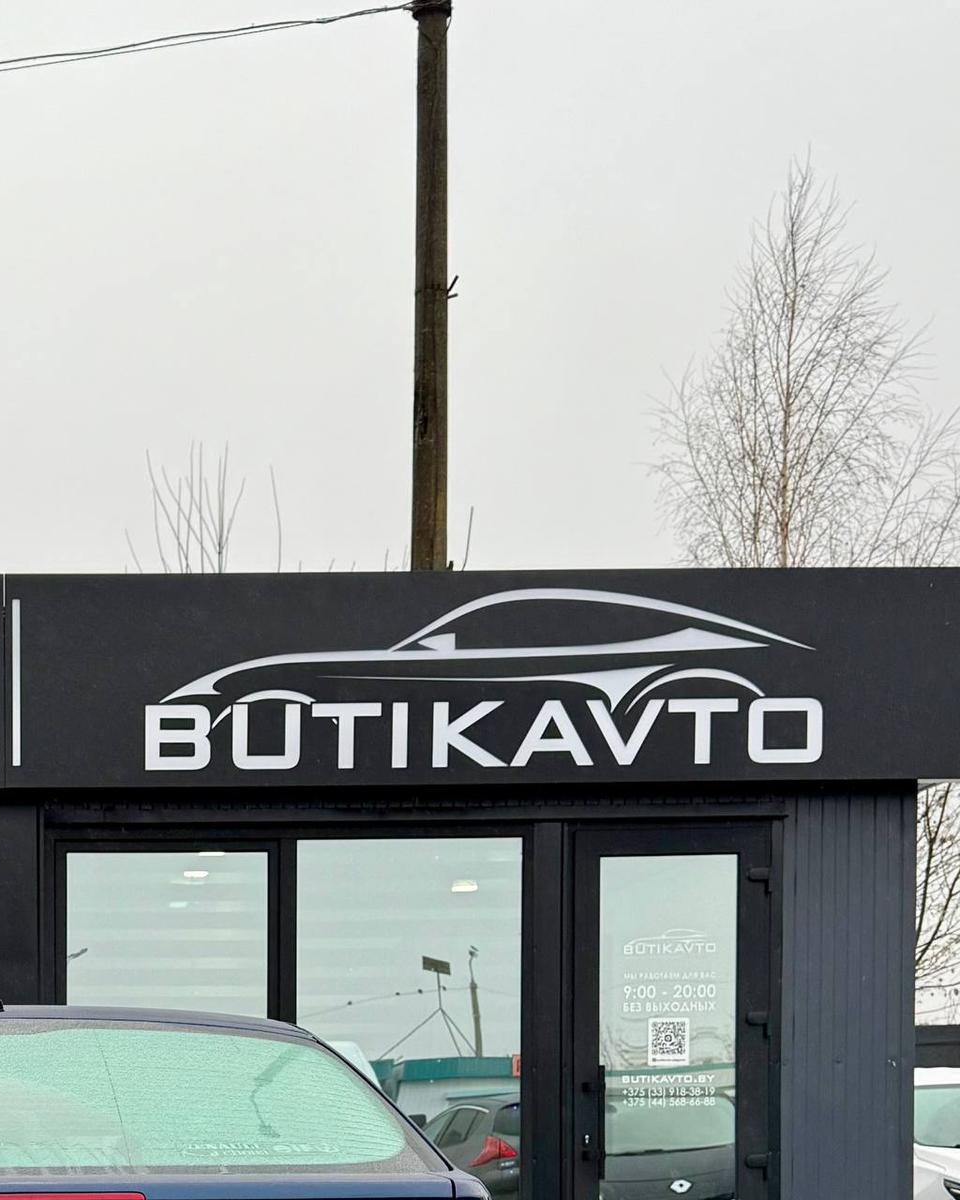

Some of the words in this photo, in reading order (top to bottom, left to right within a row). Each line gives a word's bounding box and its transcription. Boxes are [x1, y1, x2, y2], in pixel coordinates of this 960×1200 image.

[144, 697, 823, 772] BUTIKAVTO
[623, 943, 716, 954] BUTIKAVTO
[623, 985, 656, 999] 9:00
[672, 984, 716, 998] 20:00
[623, 1002, 642, 1013] БЕЗ
[646, 1001, 717, 1012] ВЫХОДНЫХ
[621, 1075, 715, 1084] BUTIKAVTO.BY
[622, 1088, 645, 1097] +375
[648, 1087, 666, 1098] (33)
[669, 1087, 716, 1096] 918-38-19
[622, 1098, 645, 1107] +375
[648, 1097, 666, 1108] (44)
[669, 1097, 716, 1106] 568-66-88
